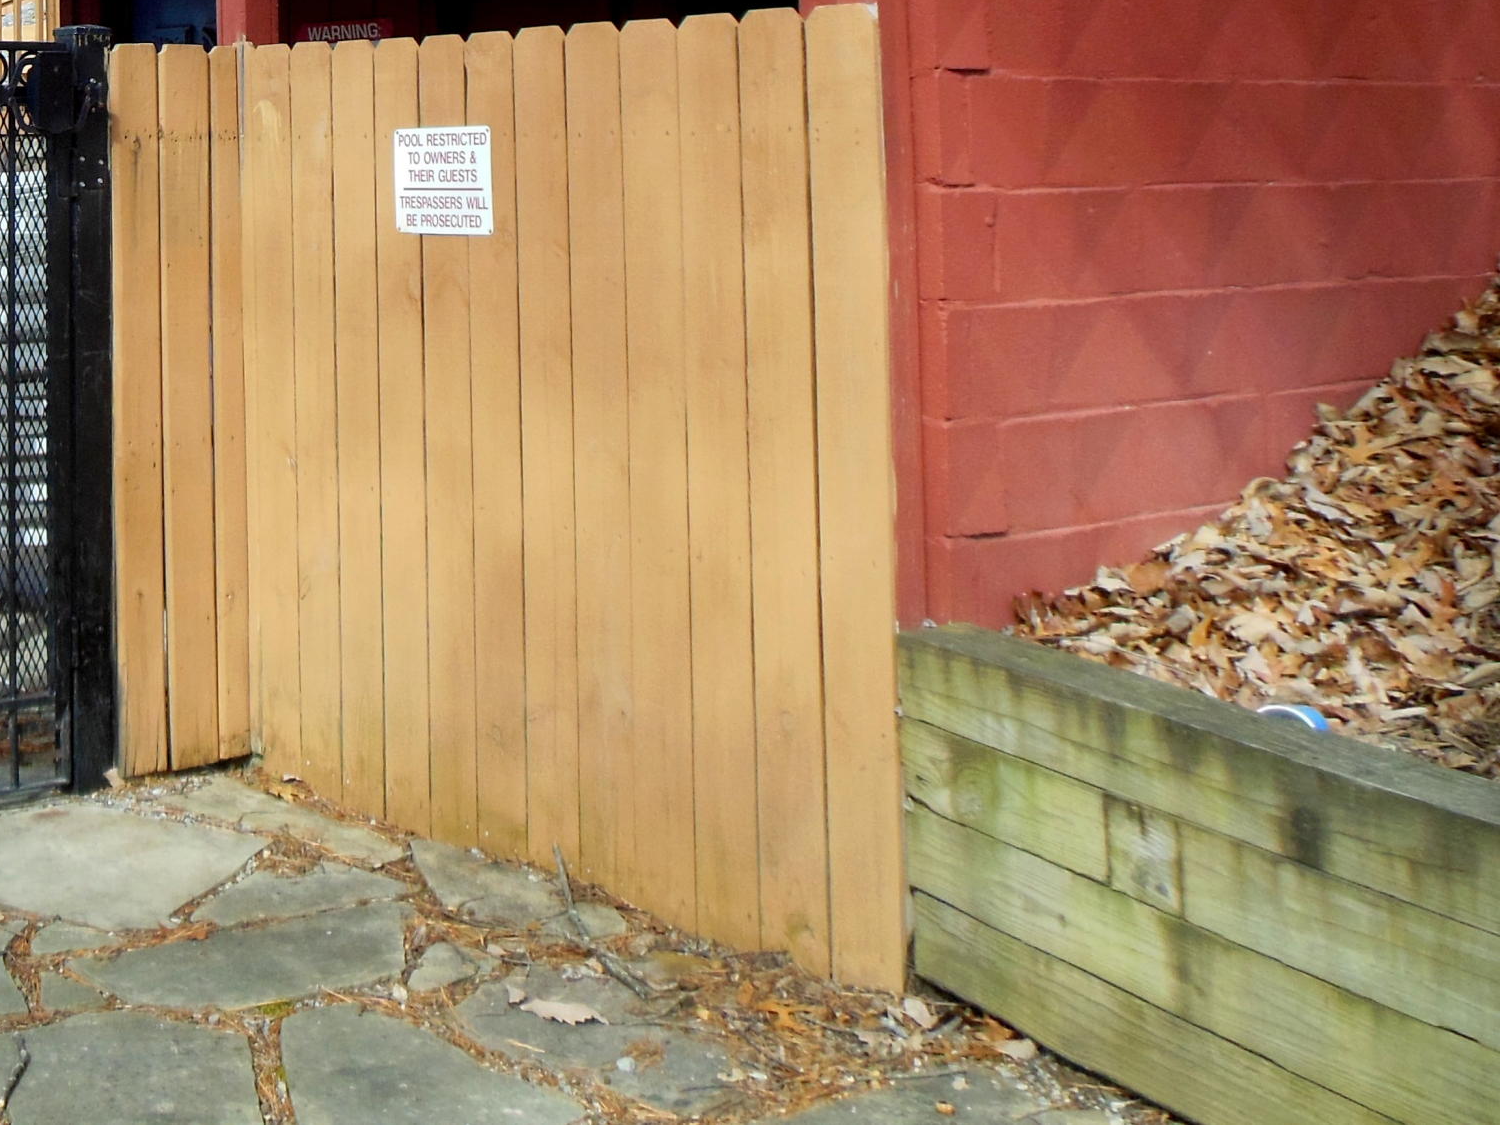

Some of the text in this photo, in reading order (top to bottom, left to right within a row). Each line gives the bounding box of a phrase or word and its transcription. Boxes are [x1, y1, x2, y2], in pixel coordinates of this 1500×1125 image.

[398, 132, 487, 147] POOL RESTRICTED
[408, 151, 476, 165] TO OWNERS &
[408, 169, 478, 183] THEIR GUESTS
[400, 196, 488, 210] TRESPASSERS WILL
[406, 214, 482, 228] BE PROSECUTED
